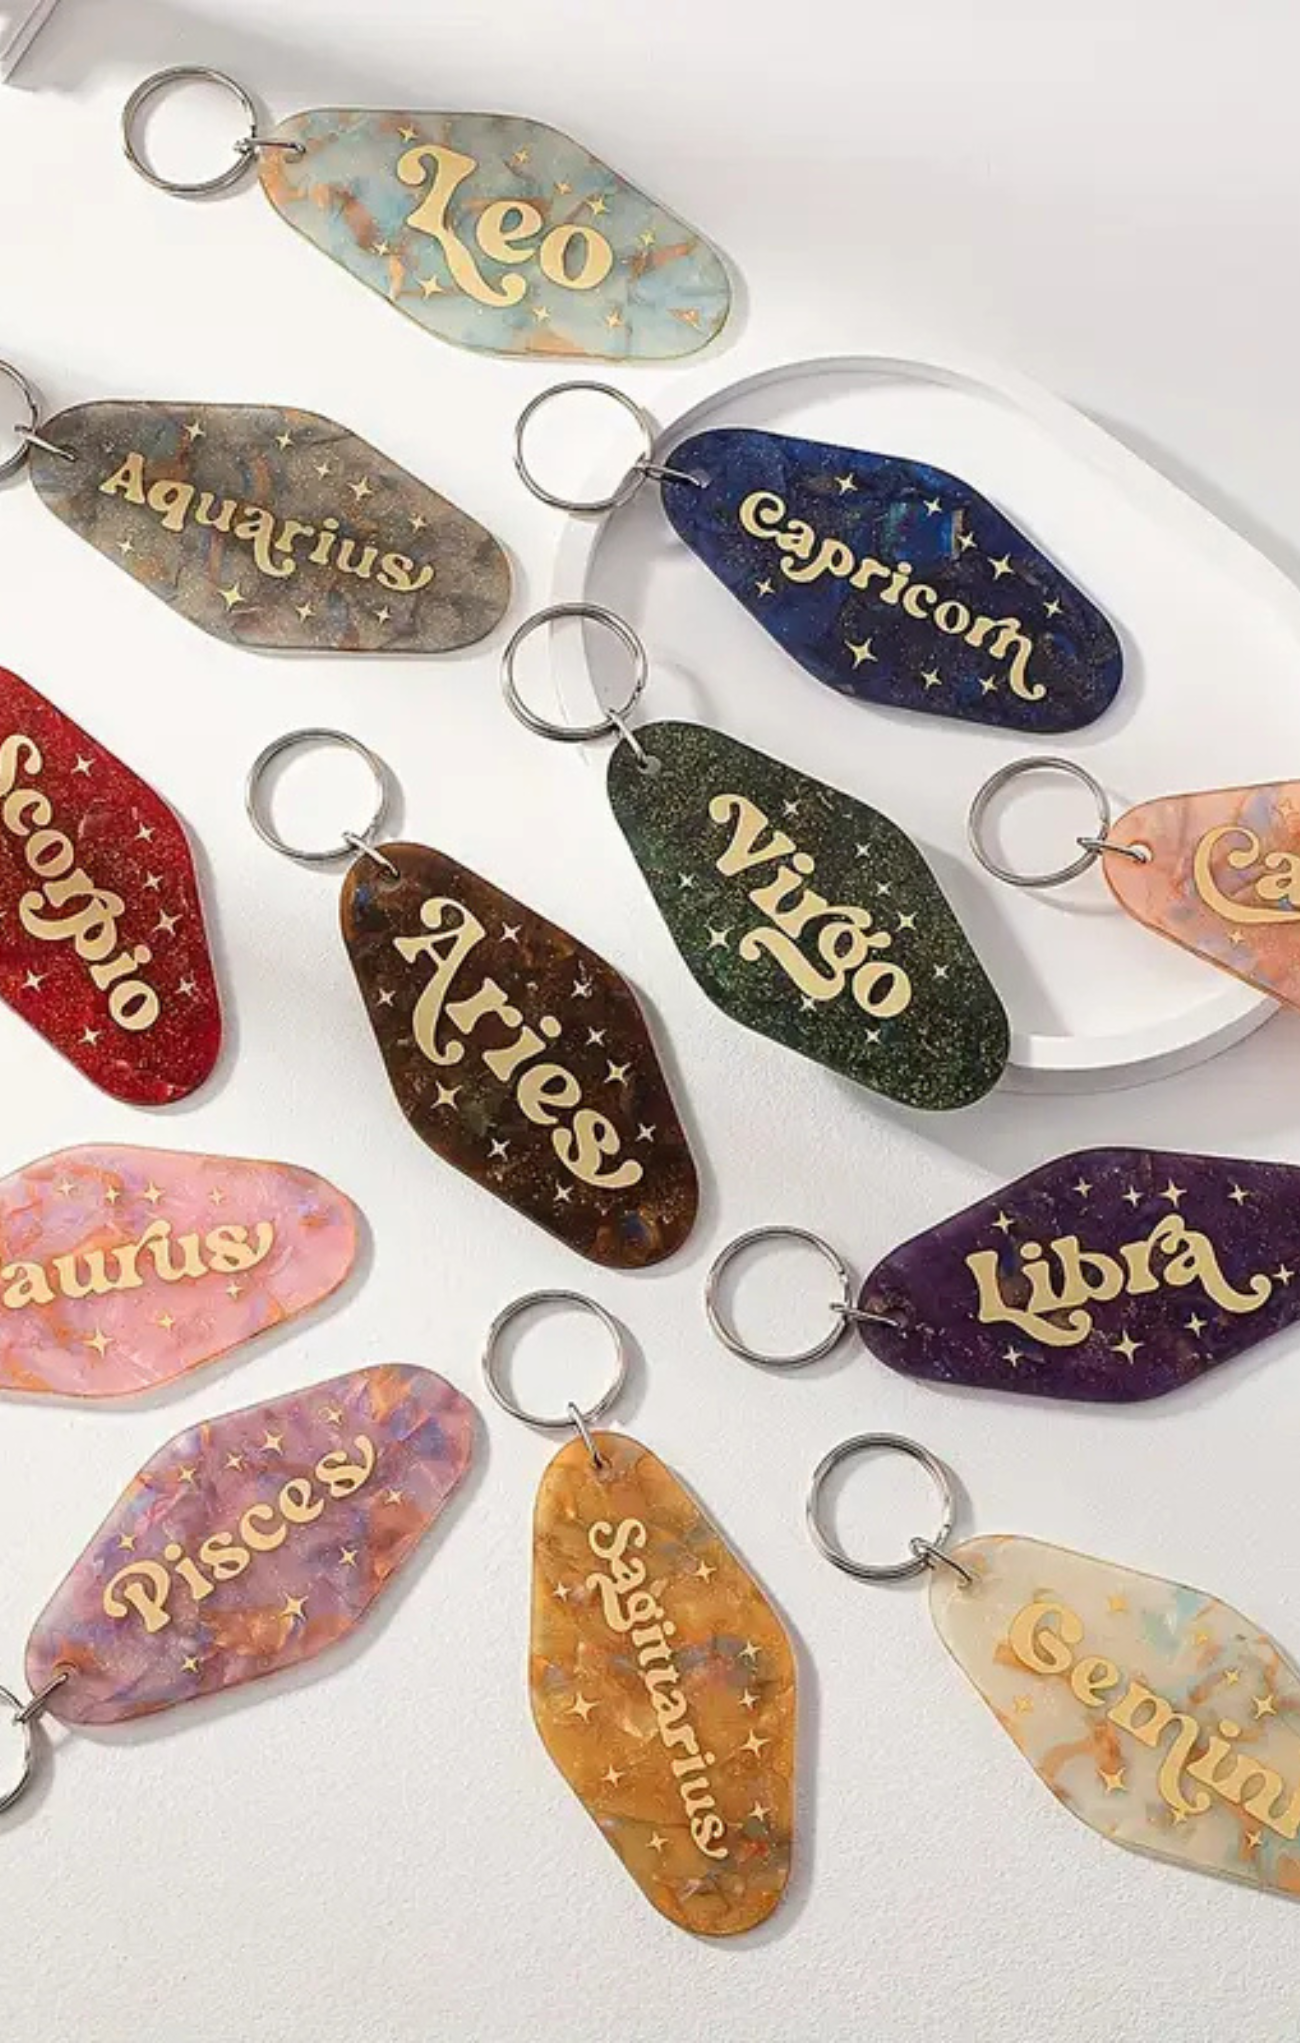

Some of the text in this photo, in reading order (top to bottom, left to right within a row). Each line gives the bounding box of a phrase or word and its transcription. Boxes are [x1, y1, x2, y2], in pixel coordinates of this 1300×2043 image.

[398, 145, 613, 307] Leo
[100, 453, 434, 594] Aquarius
[738, 490, 1047, 702] Capricorn
[708, 793, 912, 1018] Virgo
[393, 896, 643, 1190] Aries
[966, 1213, 1272, 1347] Libra
[103, 1435, 377, 1633] Pisces
[586, 1518, 728, 1860] Sagittarius
